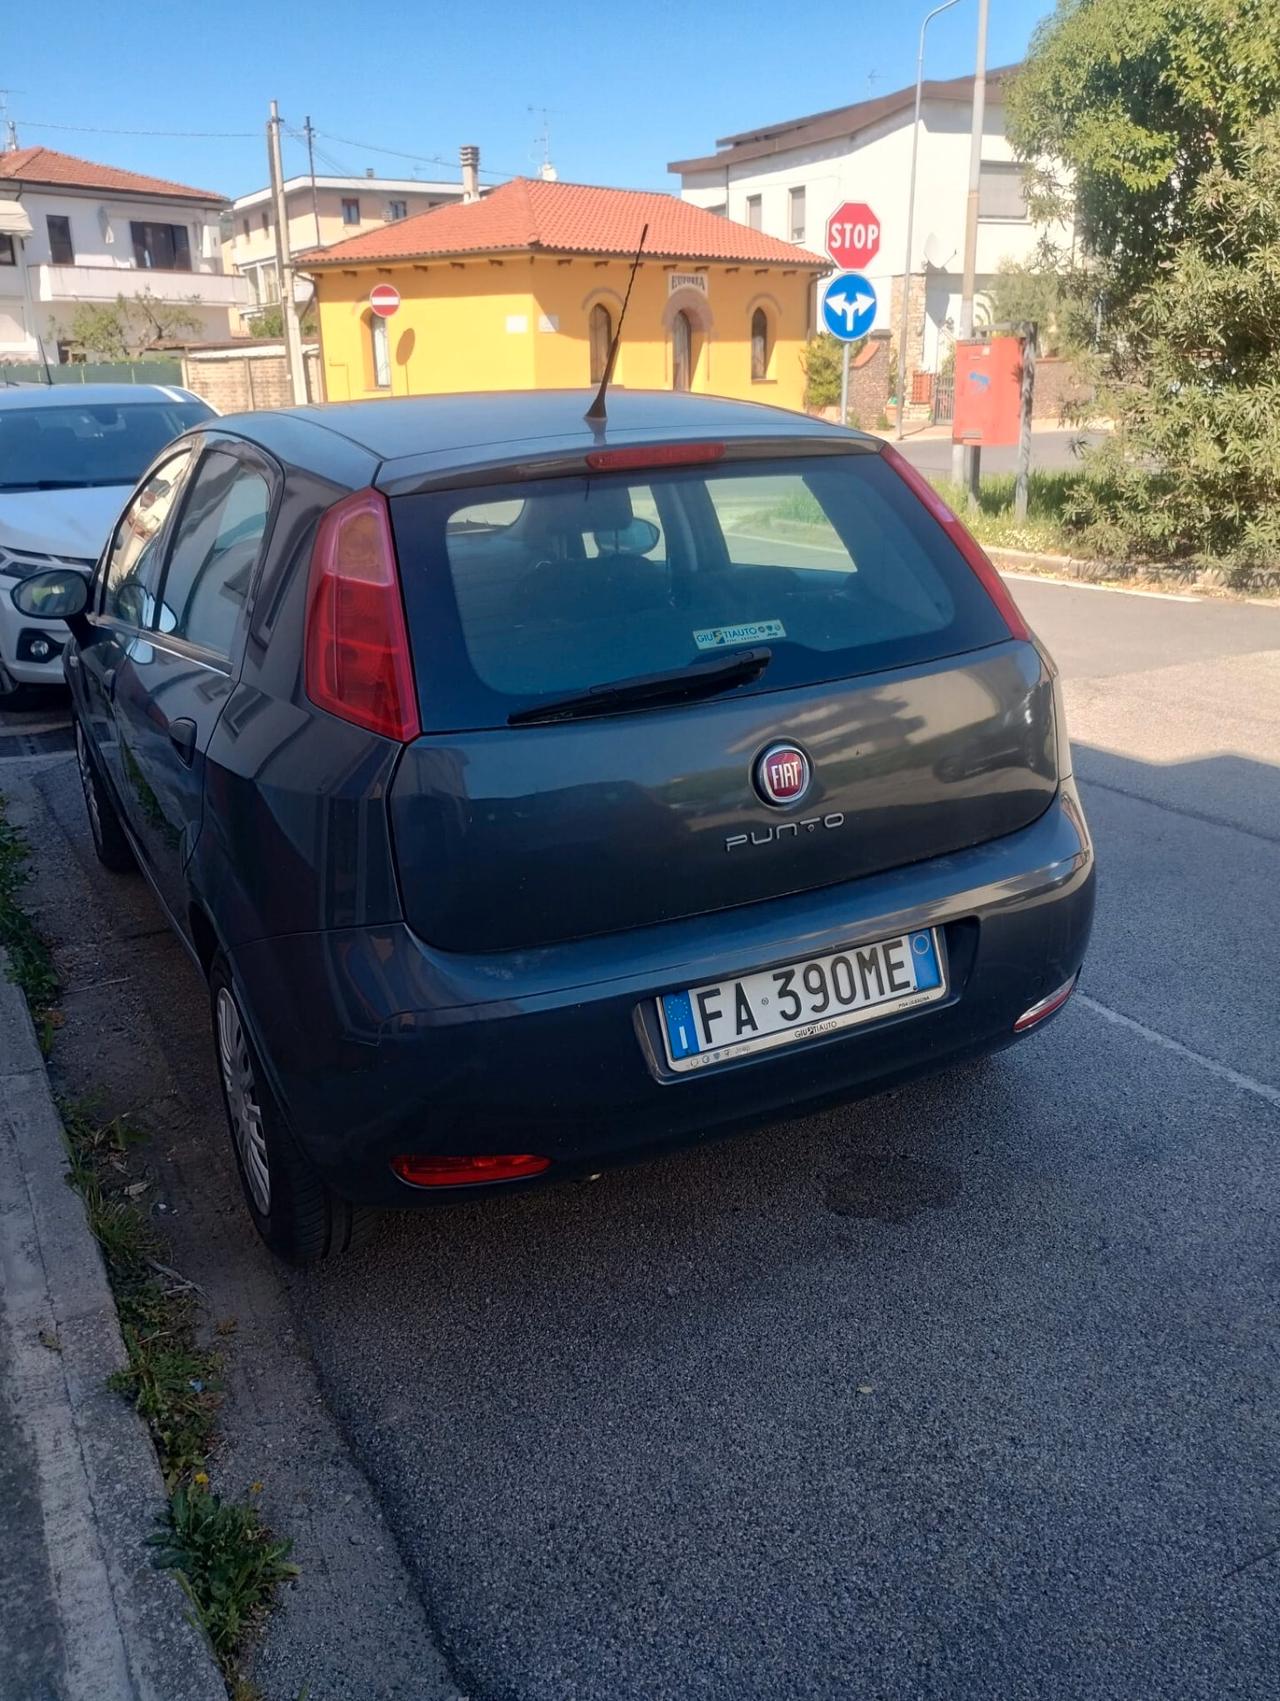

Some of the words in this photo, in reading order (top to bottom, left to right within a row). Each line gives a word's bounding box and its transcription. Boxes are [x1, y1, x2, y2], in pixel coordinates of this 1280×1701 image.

[831, 223, 879, 250] STOP
[696, 626, 758, 645] GIUSTIAUTO
[770, 761, 799, 790] FIAT
[726, 812, 844, 852] PUNTO
[679, 1025, 688, 1049] I
[697, 982, 758, 1044] FA
[772, 940, 911, 1021] 390ME
[794, 1020, 838, 1038] GIUSTIAUTO
